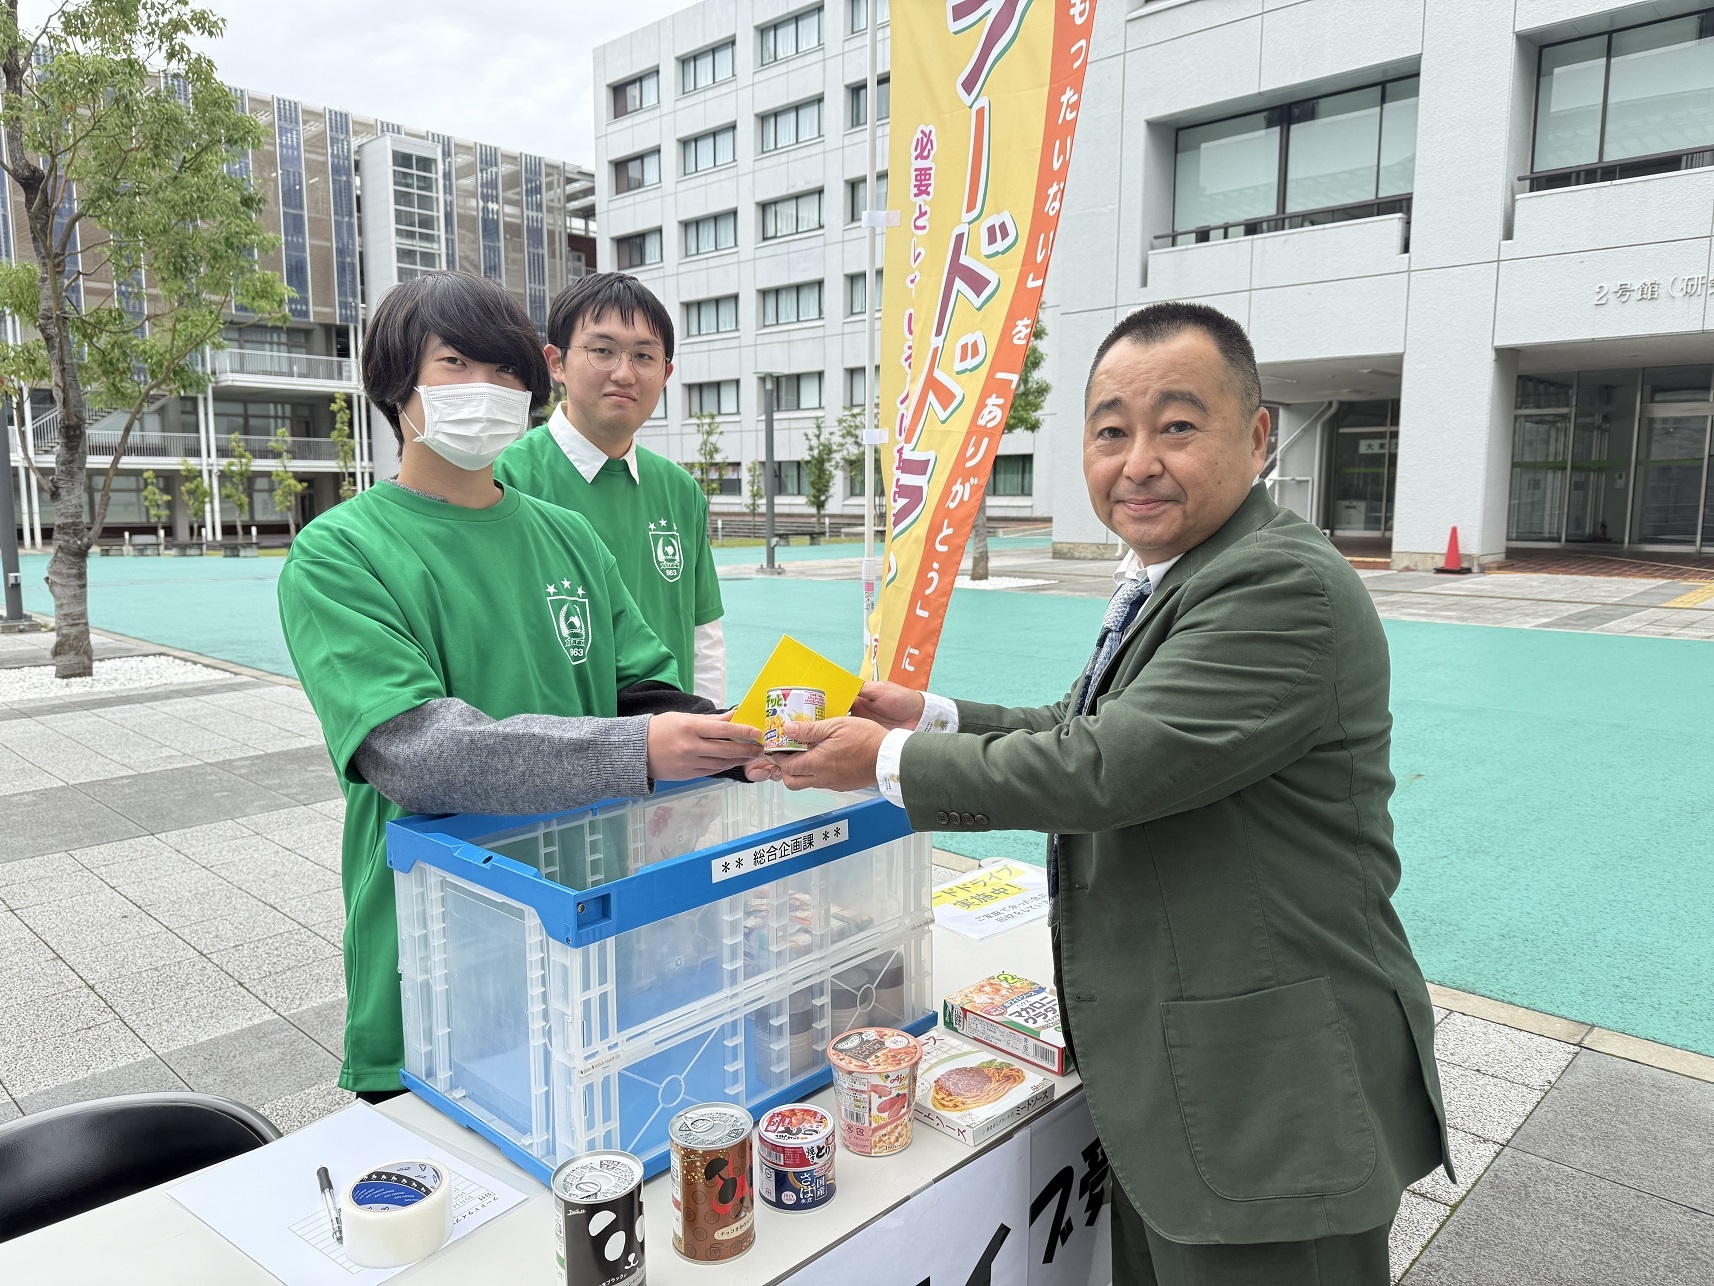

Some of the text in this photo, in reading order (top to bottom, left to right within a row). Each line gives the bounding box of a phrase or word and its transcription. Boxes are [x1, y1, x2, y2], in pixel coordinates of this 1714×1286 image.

[887, 0, 1033, 541] フードドラ
[753, 833, 815, 866] 総合企画課
[932, 864, 1013, 900] ードドライブ
[1023, 1002, 1058, 1025] グラタ
[1015, 1090, 1049, 1116] ミートソース
[914, 1108, 967, 1142] ートソース
[800, 1172, 816, 1199] さば
[453, 1196, 500, 1226] フードドライブ
